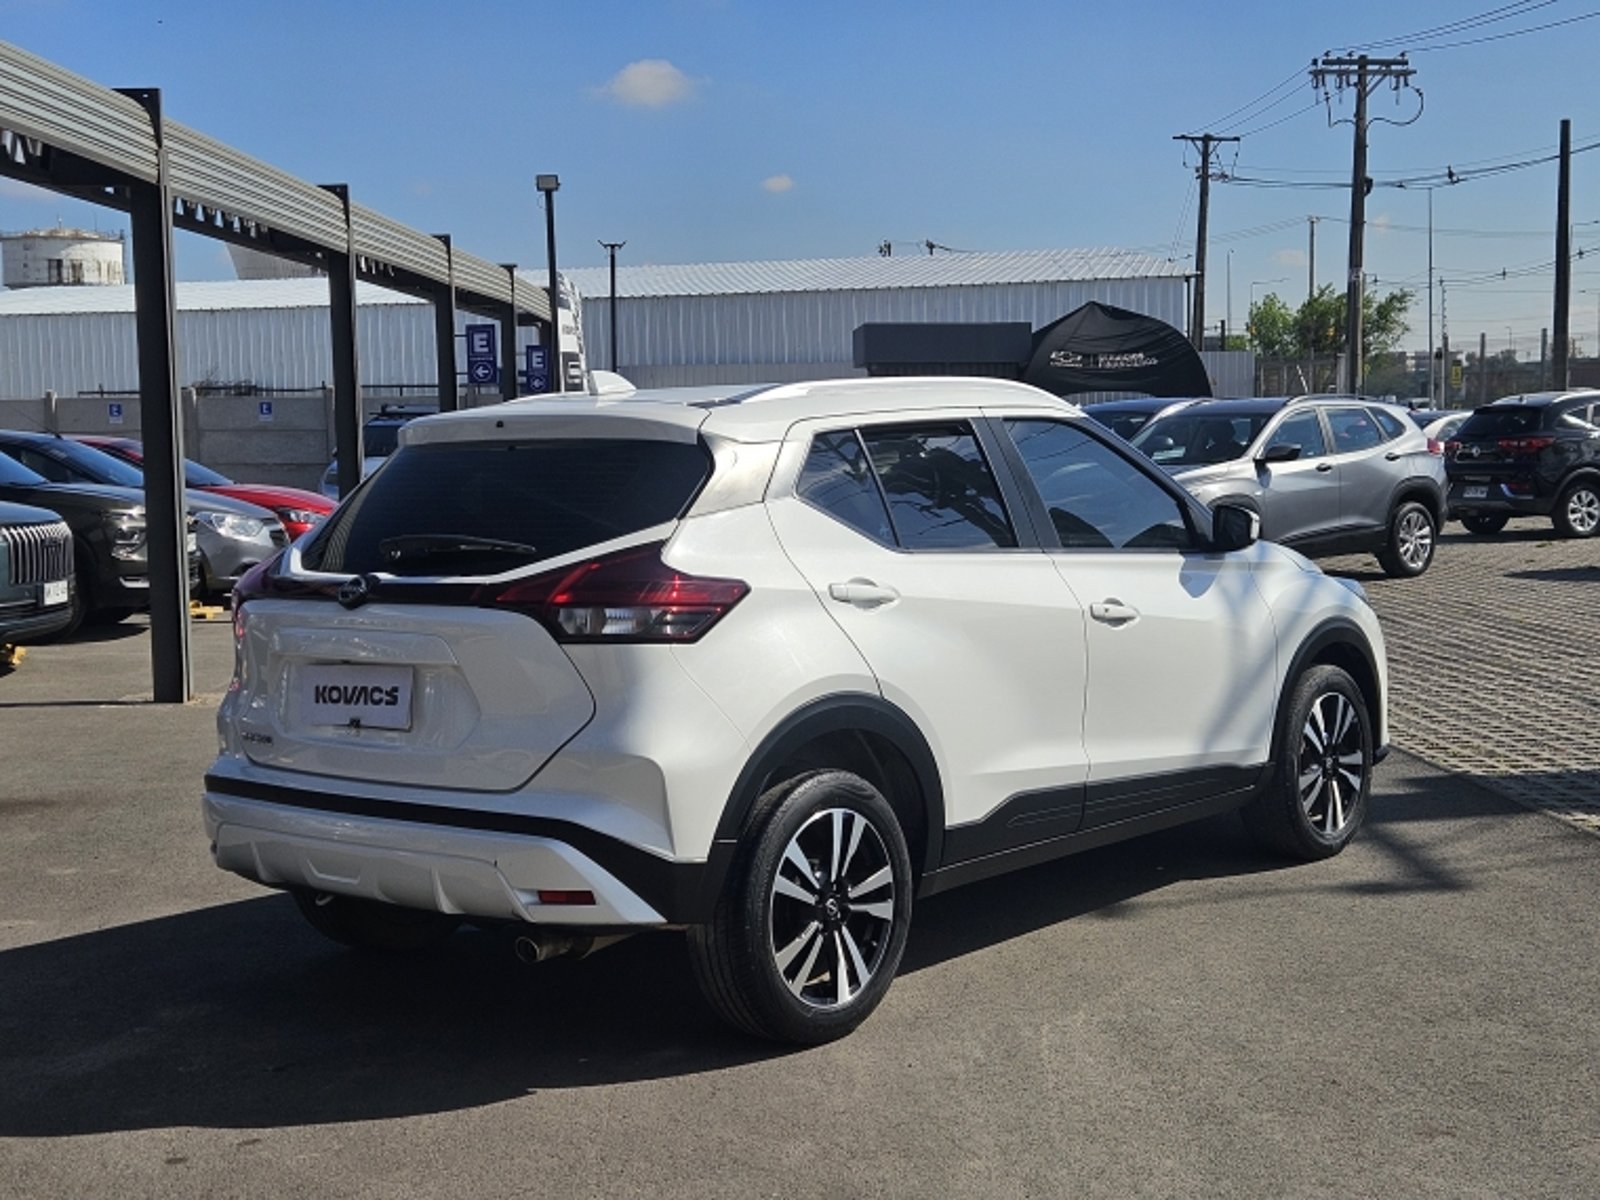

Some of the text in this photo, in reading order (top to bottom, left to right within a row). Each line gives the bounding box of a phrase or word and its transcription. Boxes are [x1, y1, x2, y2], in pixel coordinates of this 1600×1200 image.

[473, 333, 489, 353] E
[532, 352, 544, 369] E
[314, 685, 399, 706] KOVACS
